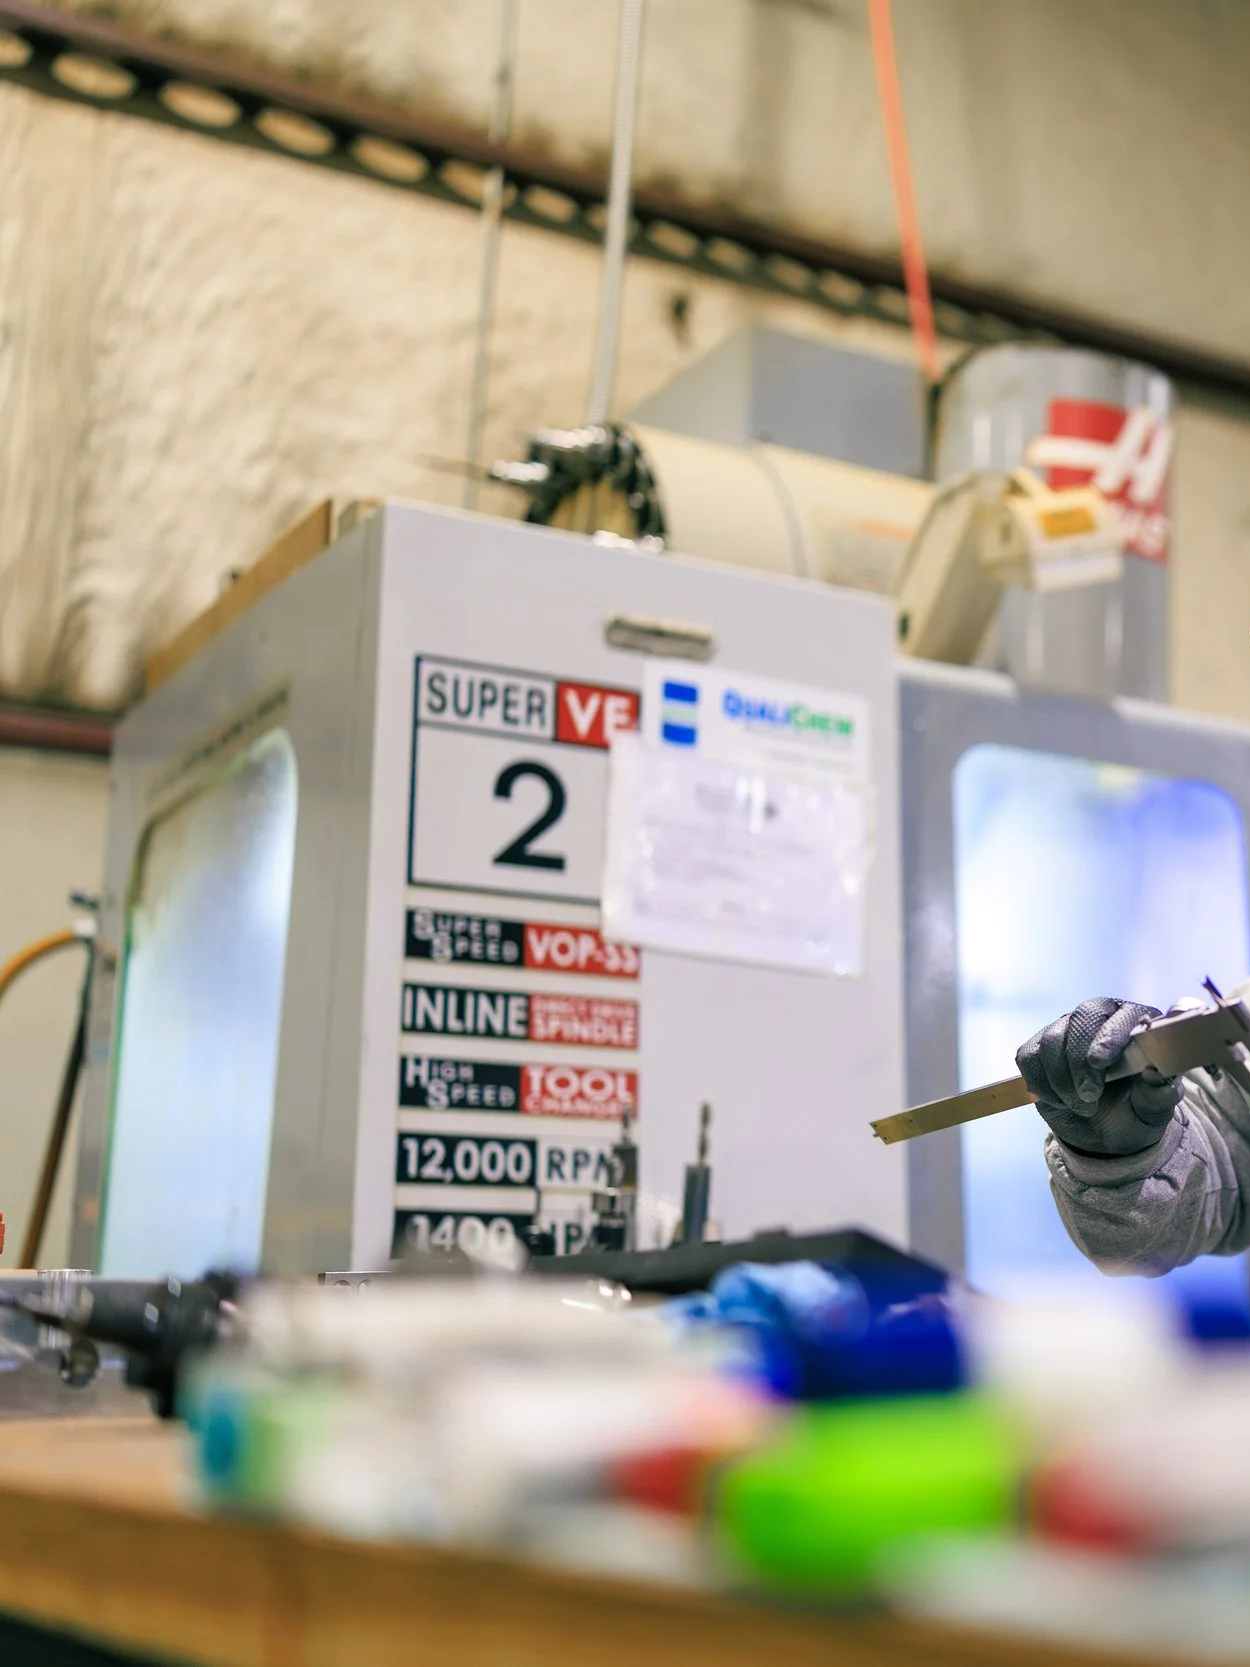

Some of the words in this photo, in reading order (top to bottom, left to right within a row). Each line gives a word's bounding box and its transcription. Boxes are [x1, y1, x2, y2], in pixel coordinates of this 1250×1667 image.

[427, 671, 547, 730] SUPER
[493, 759, 567, 872] 2
[403, 985, 528, 1037] INLINE
[532, 1011, 636, 1047] SPINDLE
[405, 1056, 474, 1088] HIGH
[525, 1065, 634, 1103] TOOL
[426, 1079, 516, 1110] SPEED
[402, 1136, 533, 1183] 12,000
